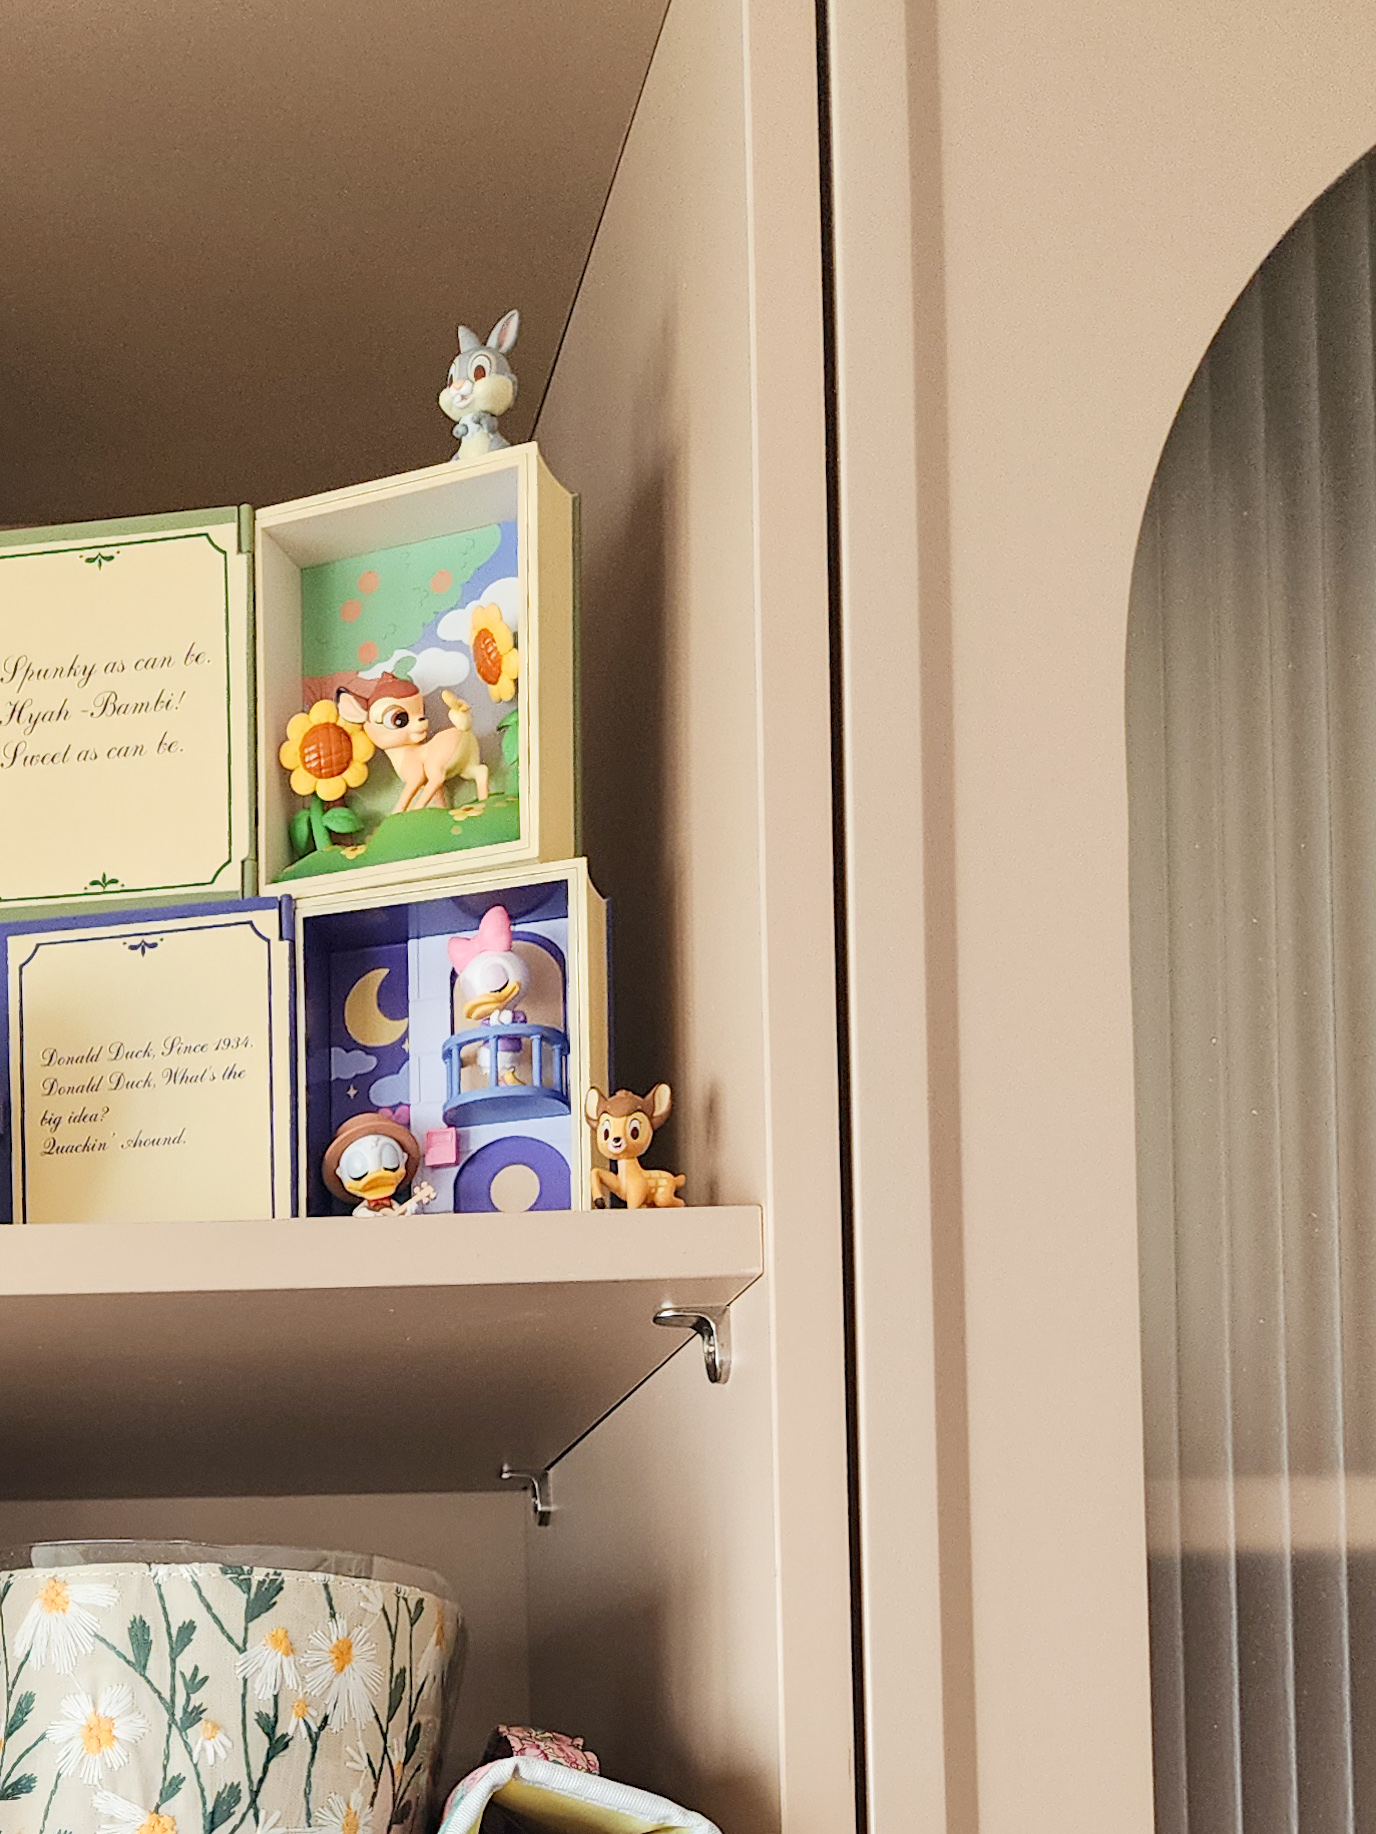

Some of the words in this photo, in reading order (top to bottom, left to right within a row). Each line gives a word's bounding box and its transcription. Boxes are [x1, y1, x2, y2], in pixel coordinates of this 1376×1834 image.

[0, 654, 96, 693] Spunky
[103, 660, 125, 674] as
[134, 654, 175, 671] can
[183, 642, 211, 666] be.
[0, 740, 71, 769] Sweet
[76, 747, 98, 761] as
[106, 744, 148, 759] can
[156, 731, 184, 754] be.
[40, 1046, 102, 1067] Donald
[107, 1041, 156, 1062] Duck,
[160, 1036, 208, 1057] Since
[213, 1034, 253, 1051] 1934.
[40, 1076, 102, 1097] Donald
[108, 1071, 156, 1091] Duck,
[161, 1066, 217, 1085] What's
[222, 1063, 246, 1081] the
[40, 1109, 62, 1132] big
[68, 1106, 110, 1123] idea?
[120, 1127, 186, 1149] Around.
